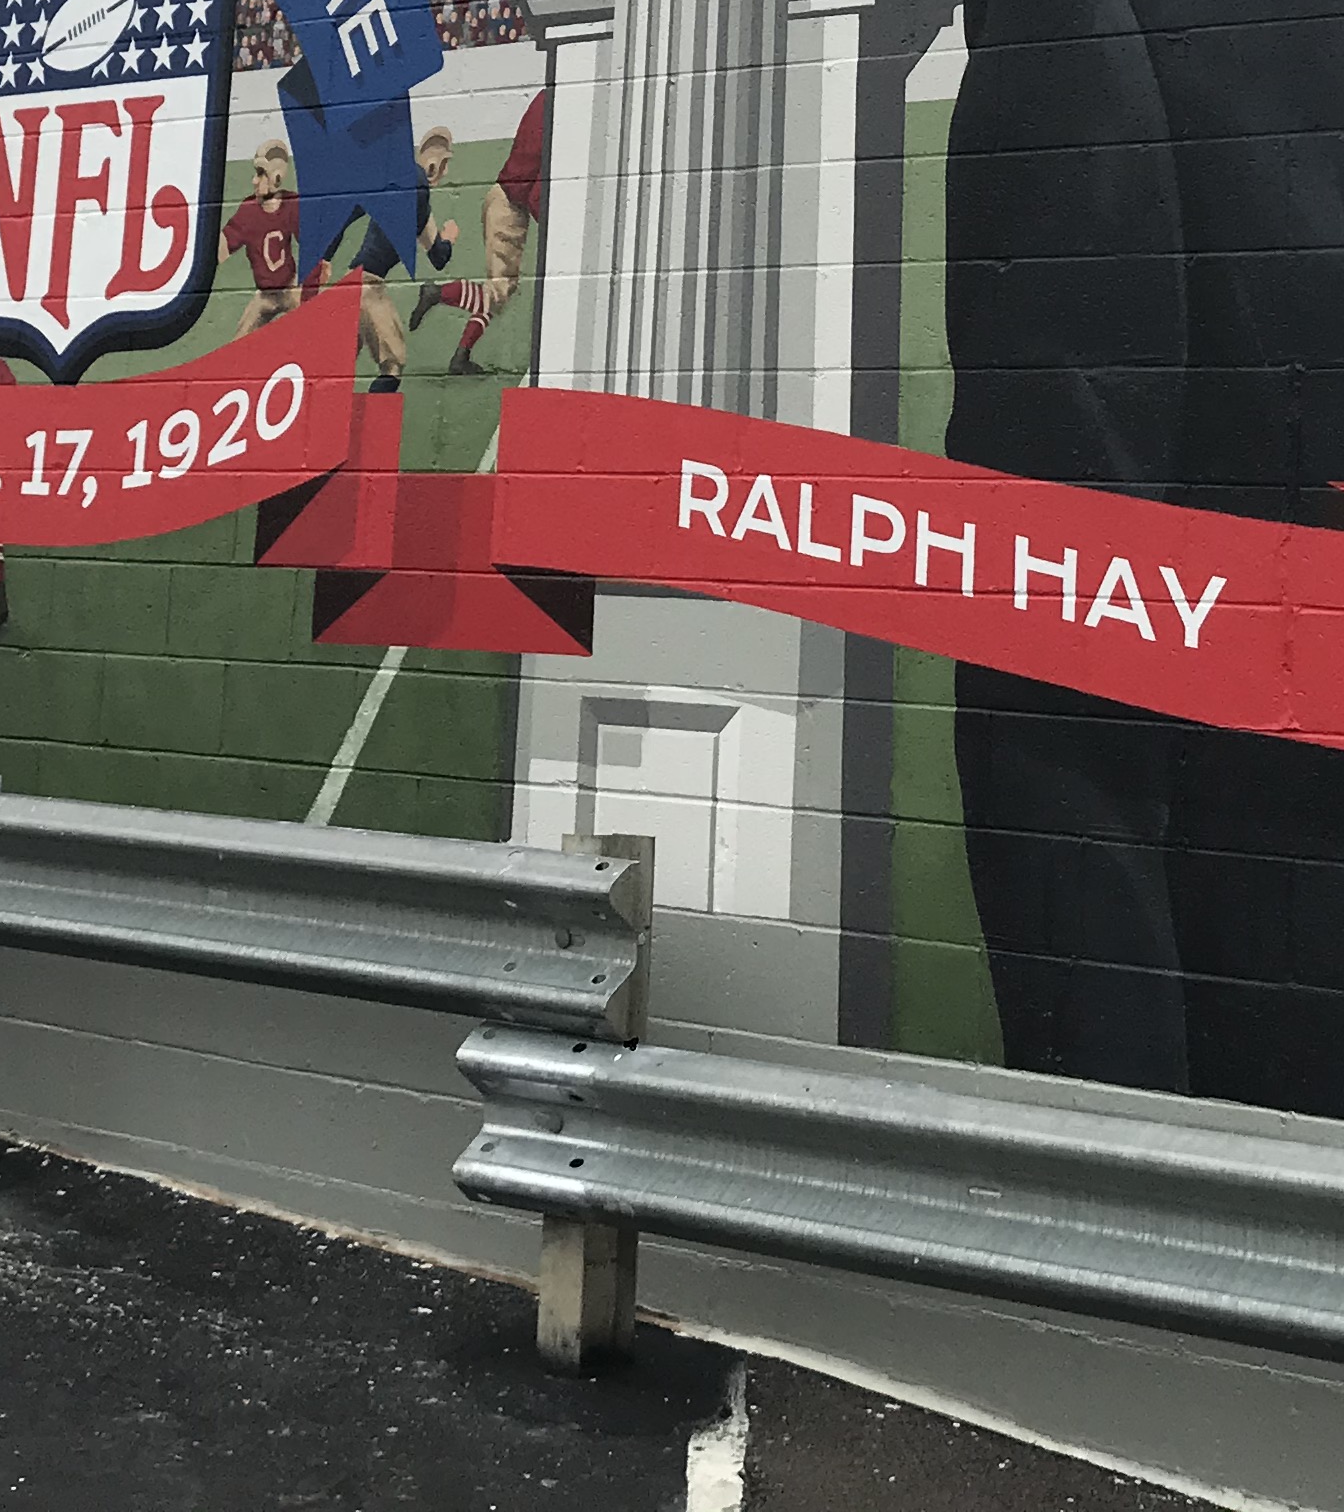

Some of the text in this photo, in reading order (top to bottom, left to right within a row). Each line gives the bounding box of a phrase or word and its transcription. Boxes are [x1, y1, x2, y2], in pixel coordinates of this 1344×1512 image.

[263, 230, 286, 272] C
[19, 428, 99, 508] 17,
[120, 362, 304, 490] 1920
[676, 457, 1229, 651] RALPH HAY
